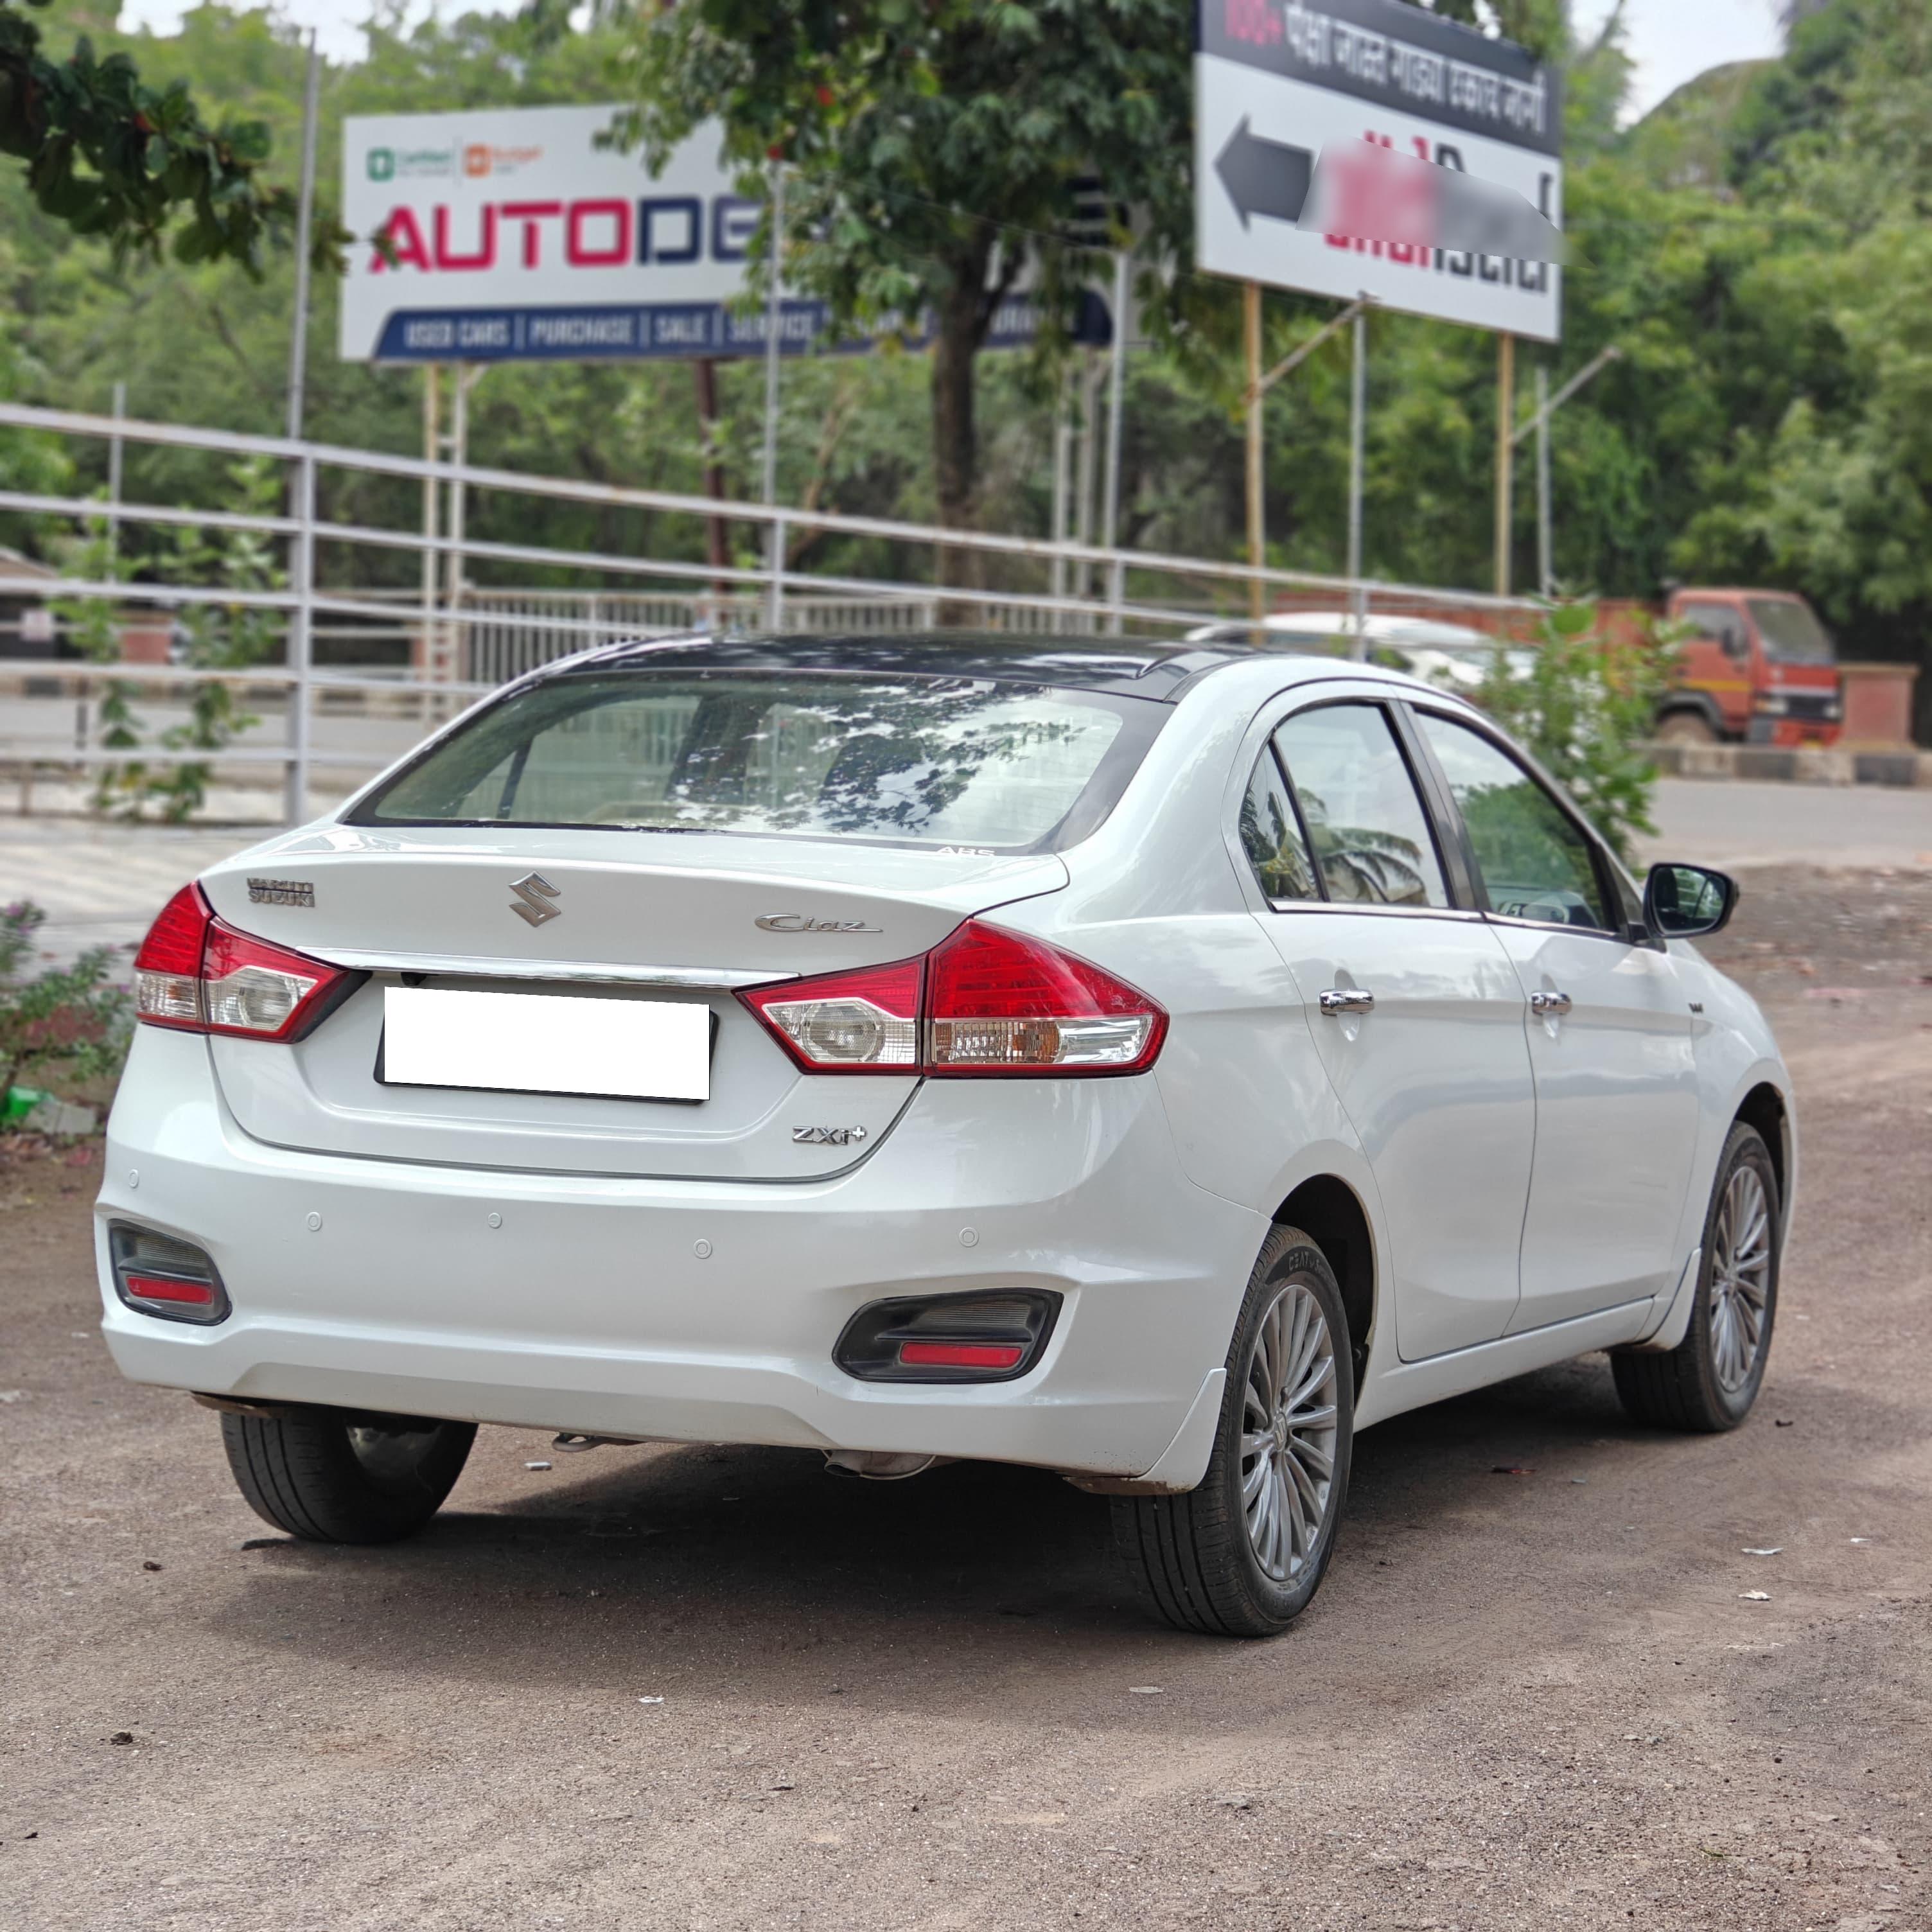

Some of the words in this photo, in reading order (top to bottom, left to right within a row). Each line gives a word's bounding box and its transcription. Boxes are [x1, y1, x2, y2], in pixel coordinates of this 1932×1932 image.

[367, 195, 775, 274] AUTODE
[405, 320, 453, 347] USED
[458, 319, 511, 346] CARS
[529, 314, 635, 346] PURCHASE
[654, 311, 705, 344] SALE
[247, 877, 314, 893] MARUTI
[248, 889, 315, 908] SUZUKI
[754, 913, 884, 932] Ciaz
[1288, 1251, 1310, 1271] CEAT
